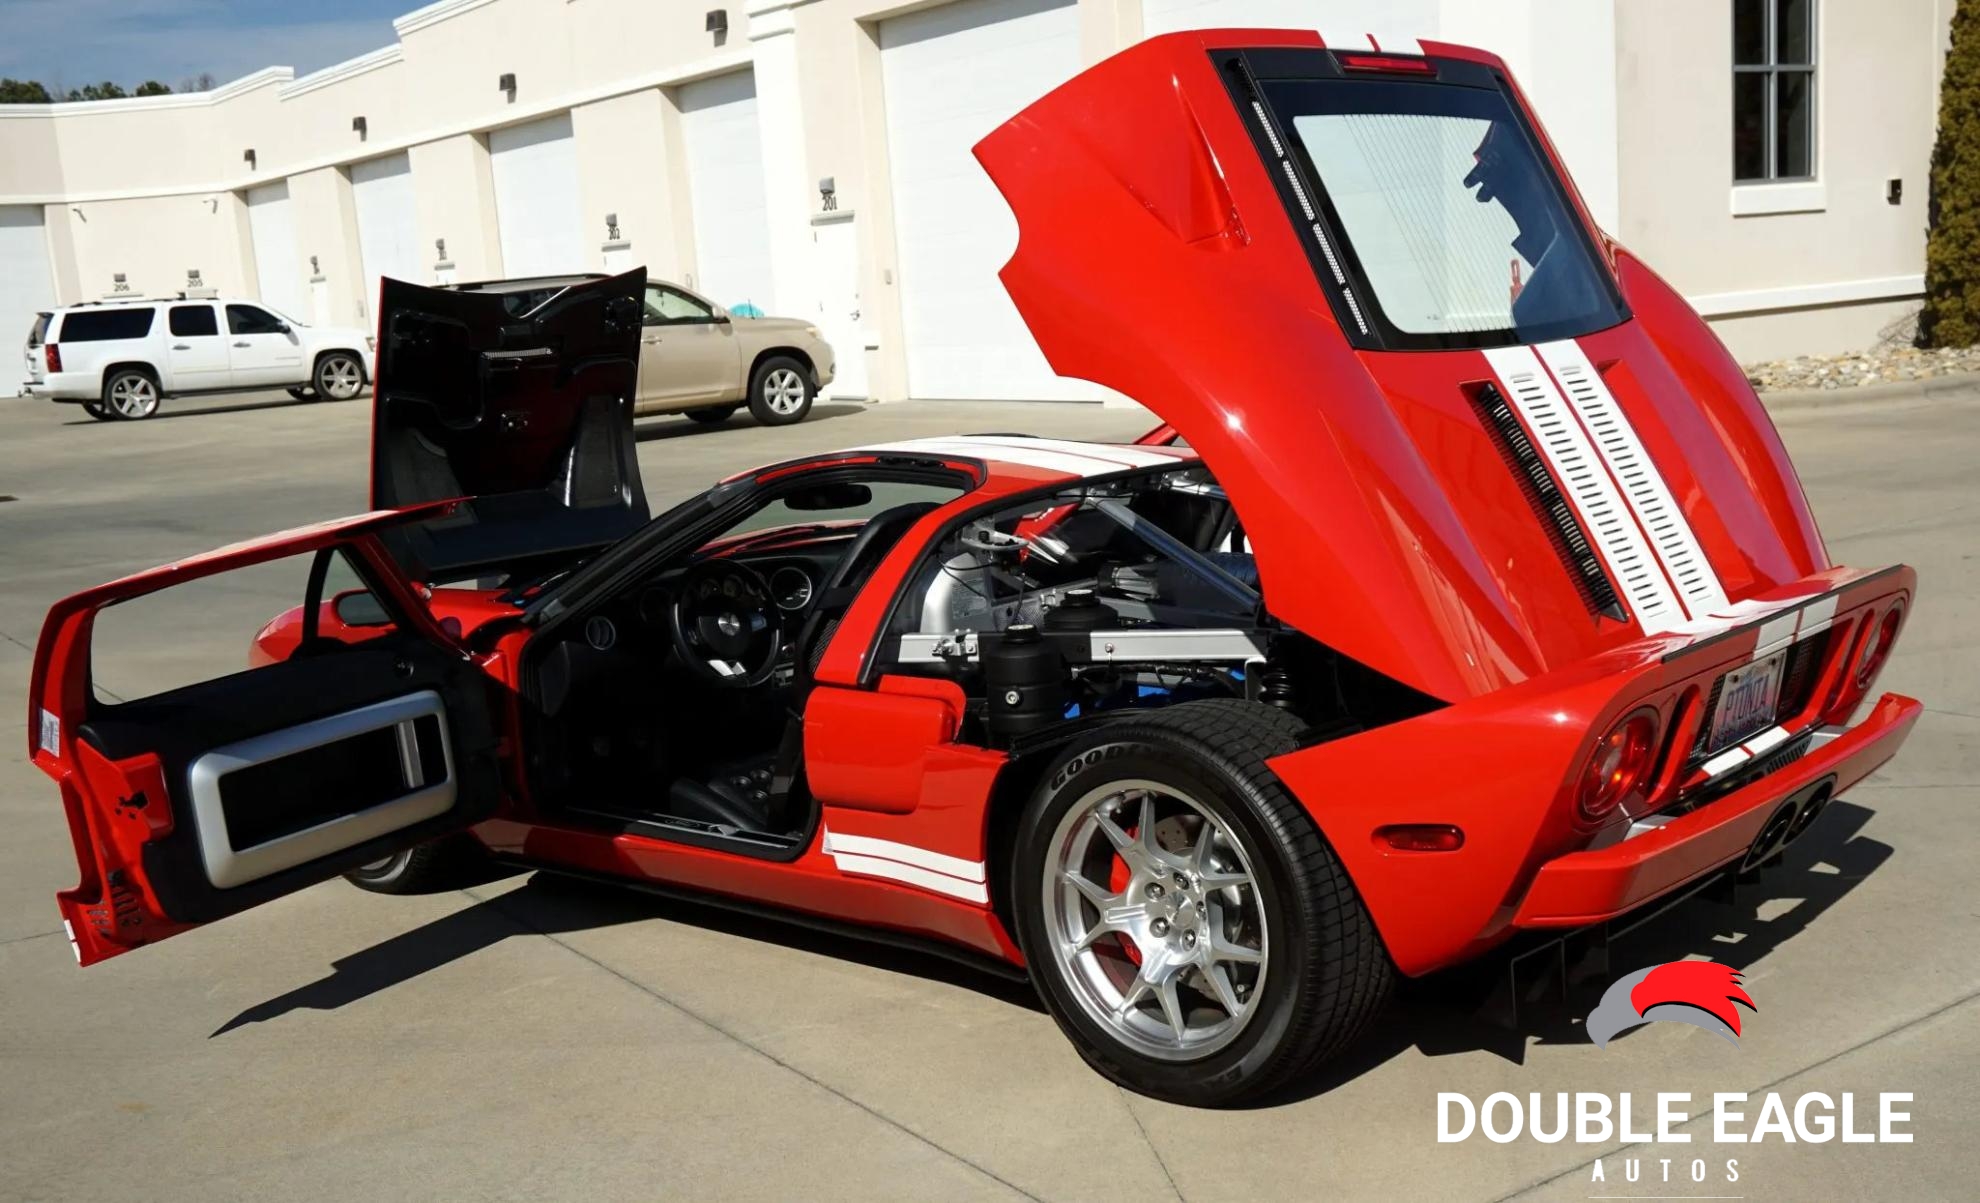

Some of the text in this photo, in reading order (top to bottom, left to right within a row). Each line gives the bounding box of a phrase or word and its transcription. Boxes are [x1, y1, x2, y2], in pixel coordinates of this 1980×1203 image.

[822, 195, 838, 211] 201
[113, 283, 130, 292] 206
[187, 279, 203, 288] 205
